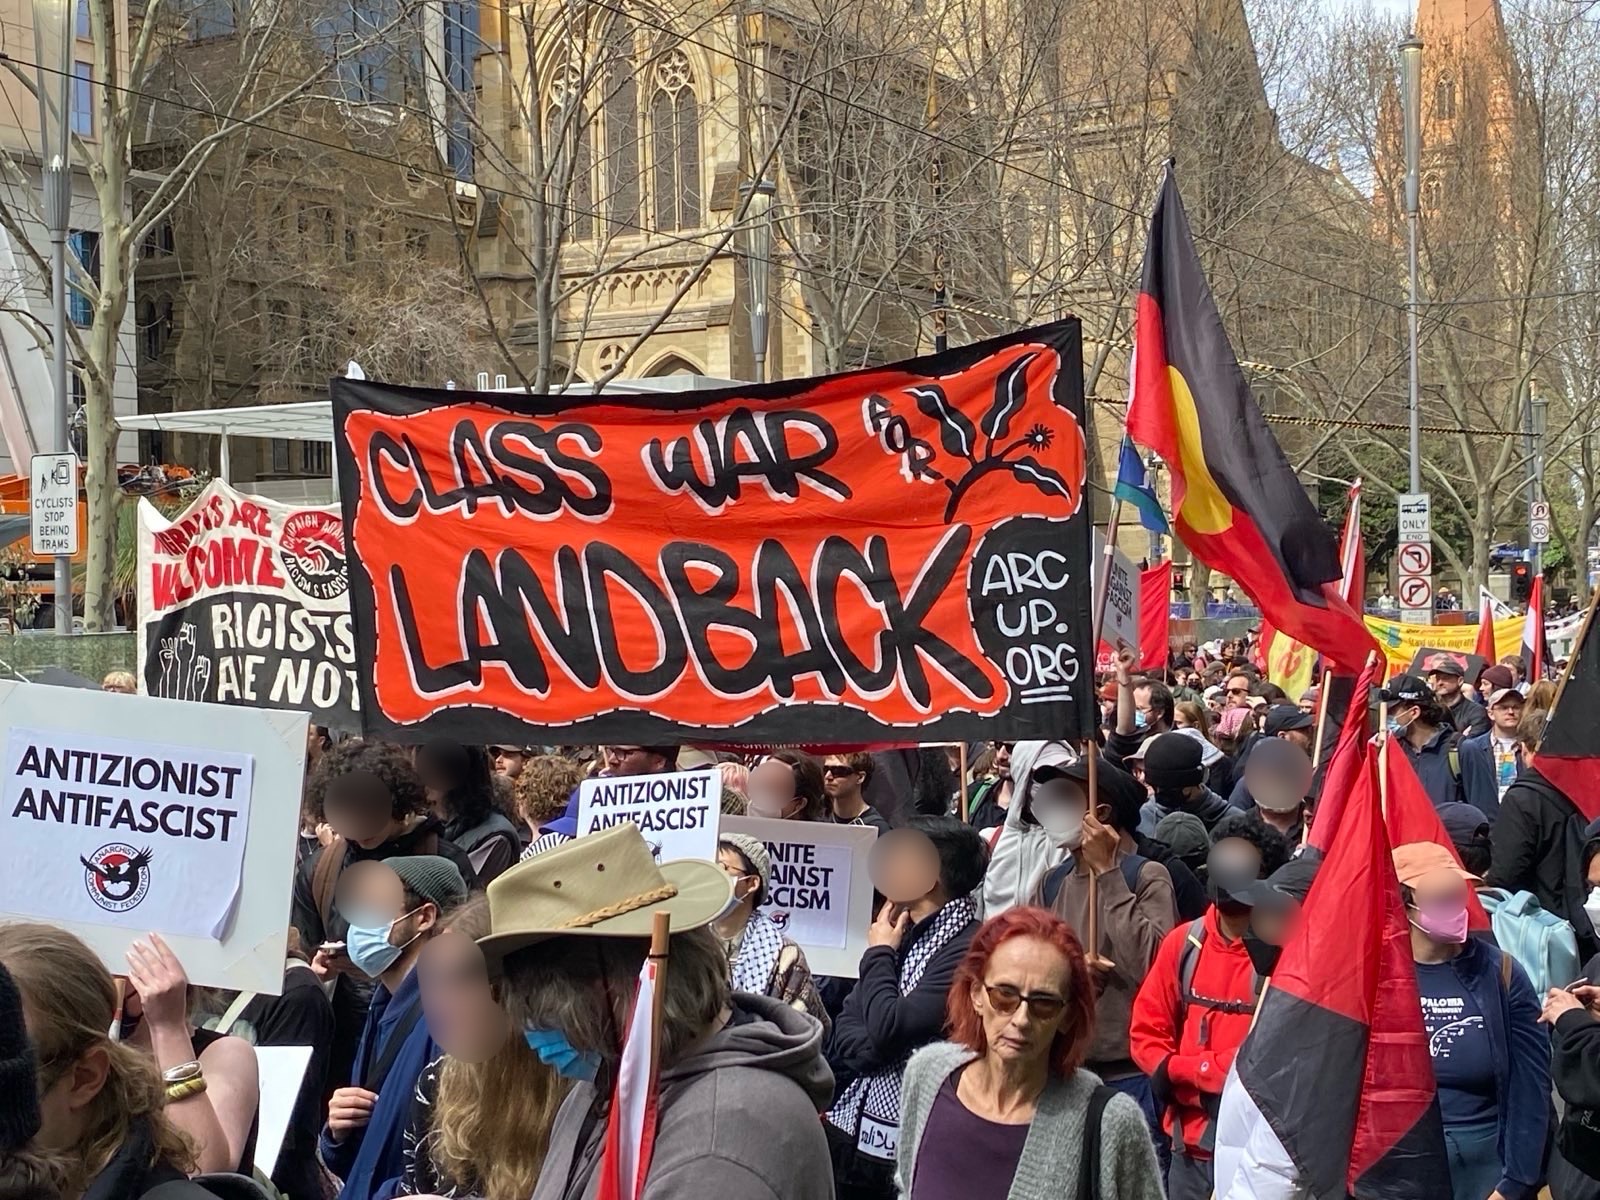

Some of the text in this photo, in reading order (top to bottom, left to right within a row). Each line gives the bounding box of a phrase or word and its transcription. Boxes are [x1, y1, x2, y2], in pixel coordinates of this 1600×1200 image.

[368, 392, 945, 526] CLASS WAR FOR
[35, 497, 74, 509] CYCLISTS
[44, 511, 65, 522] STOP
[228, 498, 273, 538] ARE
[40, 525, 70, 536] BEHIND
[1402, 519, 1426, 529] ONLY
[1533, 527, 1546, 535] 30
[41, 539, 69, 550] TRAMS
[284, 557, 312, 593] RACISM
[981, 549, 1070, 597] ARC
[389, 523, 995, 714] LANDBACK
[996, 598, 1069, 638] UP.
[1005, 642, 1080, 686] ORG
[15, 745, 242, 800] ANTIZIONIST
[589, 775, 711, 808] ANTIZIONIST
[12, 787, 238, 842] ANTIFASCIST
[94, 845, 137, 864] ANARCHIST
[87, 866, 148, 909] COMMUNIST FEDERATION
[770, 864, 834, 888] AINST
[762, 886, 831, 911] SCISM
